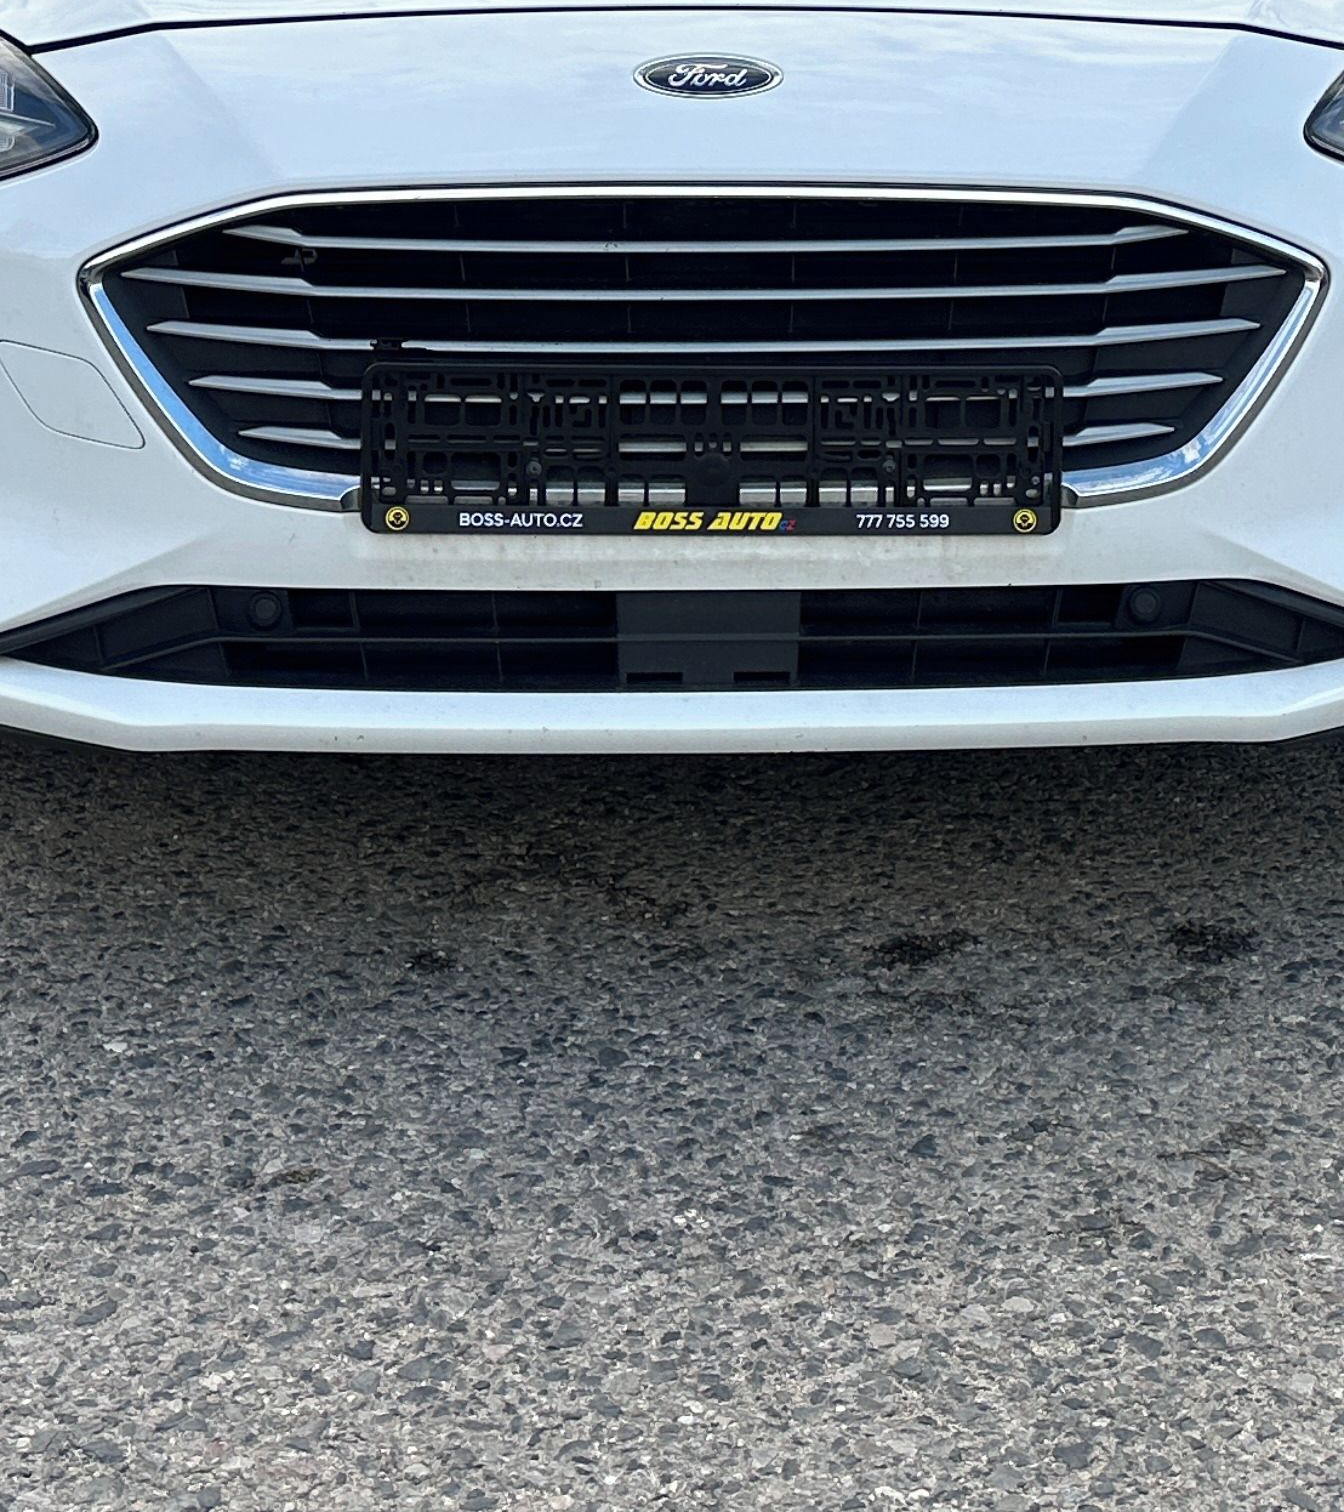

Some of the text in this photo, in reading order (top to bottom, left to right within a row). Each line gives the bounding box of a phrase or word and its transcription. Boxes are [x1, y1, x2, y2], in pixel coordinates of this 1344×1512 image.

[668, 63, 748, 87] Ford
[459, 512, 584, 529] BOSS-AUTO.CZ
[634, 512, 704, 530] BOSS
[707, 512, 782, 530] AUTO
[856, 514, 950, 529] 777 755 599
